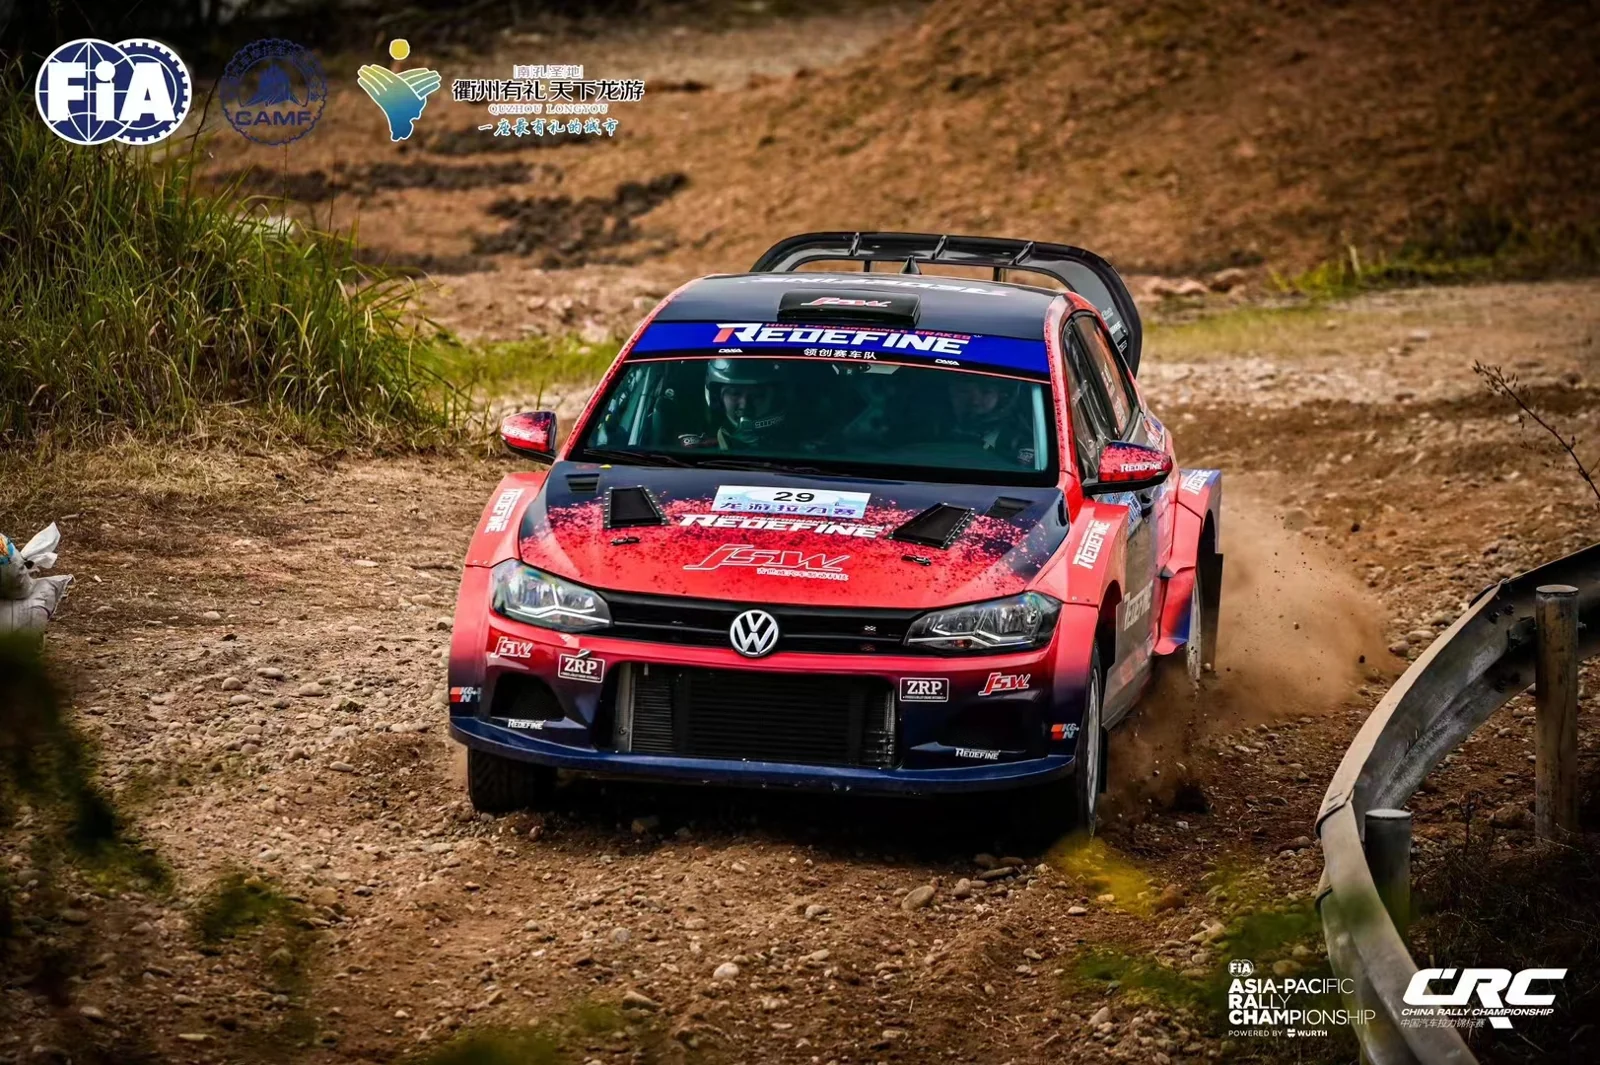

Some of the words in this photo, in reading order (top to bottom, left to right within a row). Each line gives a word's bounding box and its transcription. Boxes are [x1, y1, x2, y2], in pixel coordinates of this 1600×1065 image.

[712, 323, 969, 355] REDEFINE
[804, 348, 877, 360] 领创赛车队
[1121, 462, 1162, 472] REDEFINE
[773, 491, 815, 503] 29
[680, 514, 884, 538] REDEFINE
[1073, 519, 1111, 570] REDEFINE
[564, 657, 597, 675] ZRP
[907, 680, 943, 695] ZRP
[978, 672, 1031, 696] JSW
[508, 719, 546, 730] REDEFINE
[956, 748, 1000, 760] REDEFINE
